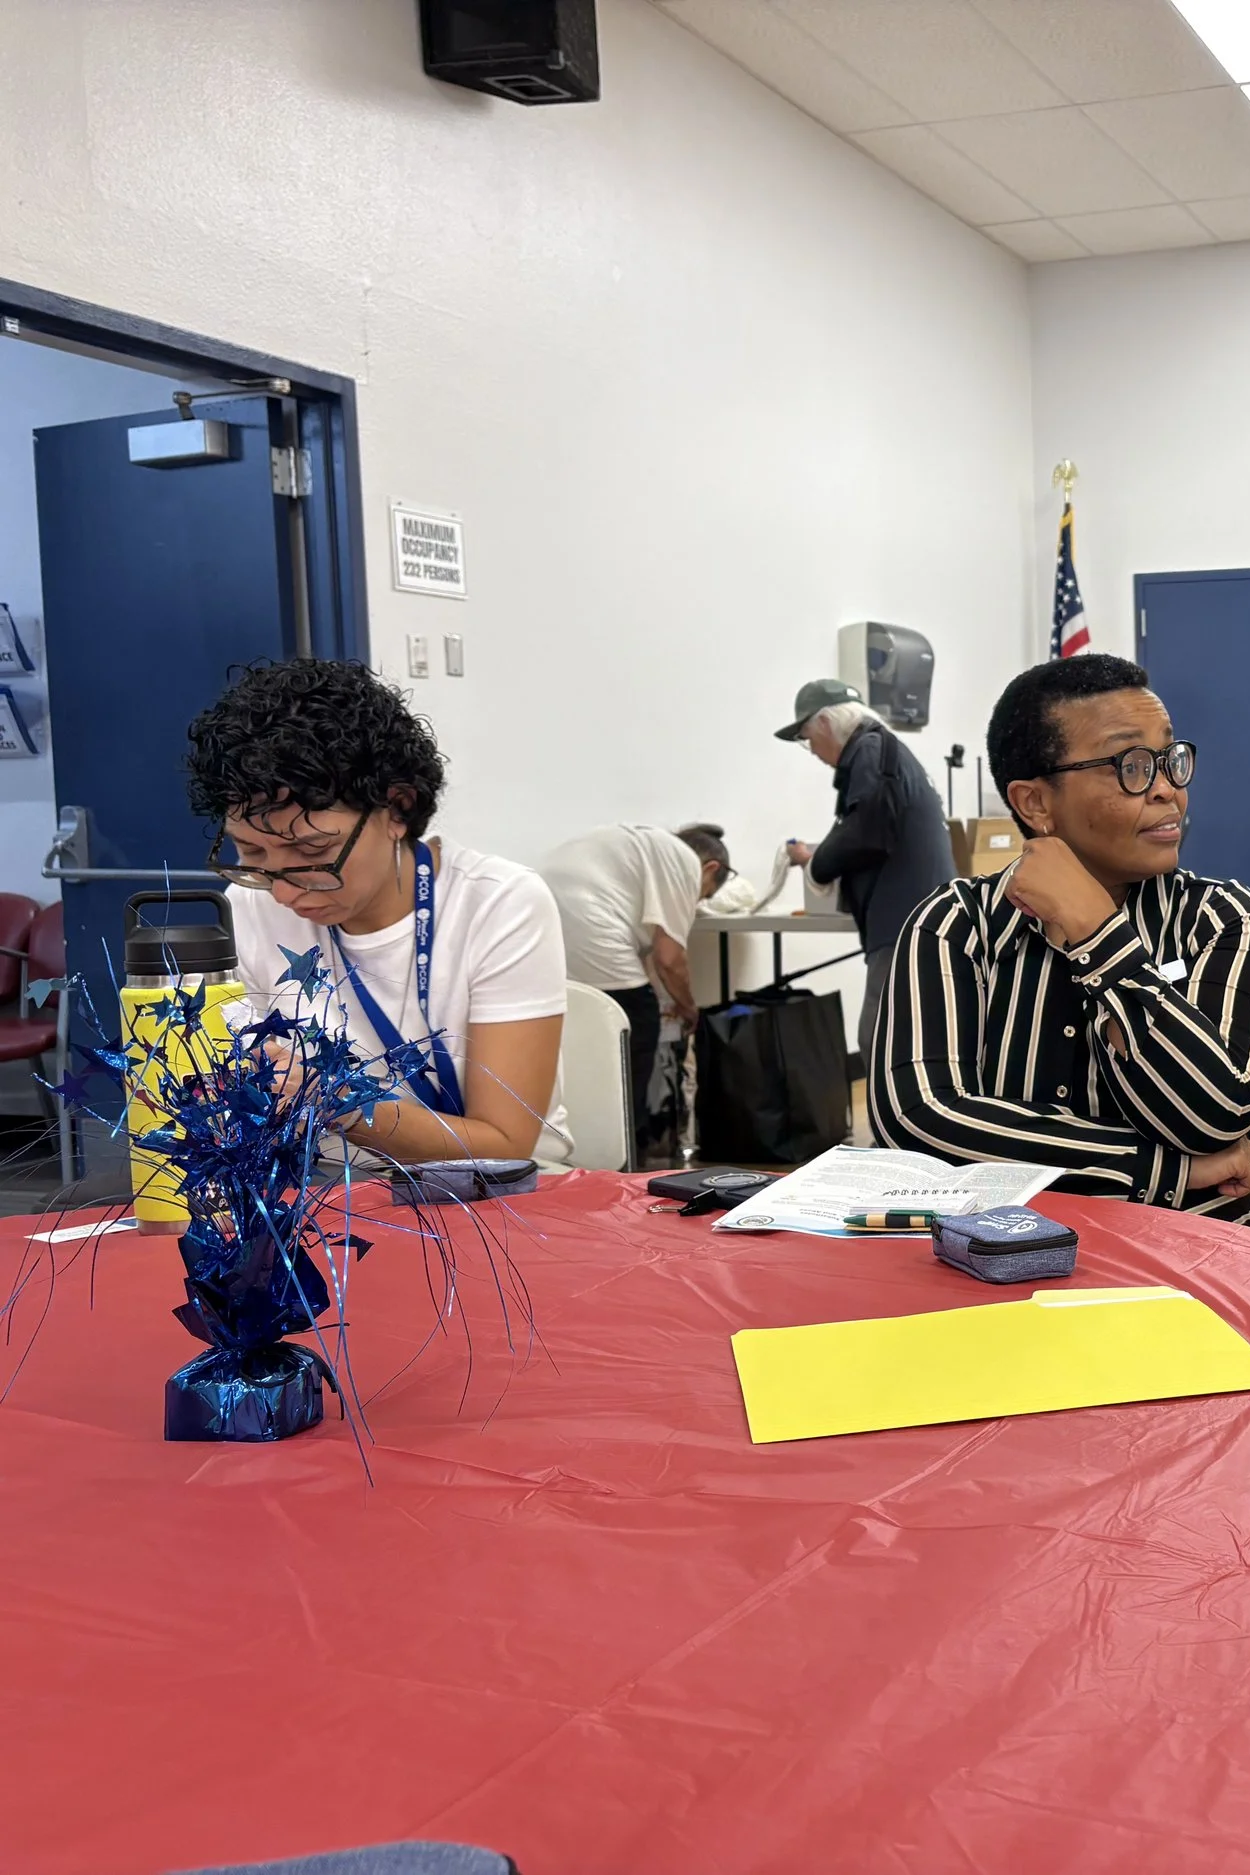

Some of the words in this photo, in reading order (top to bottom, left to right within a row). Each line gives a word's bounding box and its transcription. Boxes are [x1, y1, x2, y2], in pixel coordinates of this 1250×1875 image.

[403, 518, 455, 543] MAXIMUM
[402, 537, 458, 564] OCCUPANCY
[423, 564, 460, 584] PERSONS
[418, 875, 430, 902] PCOA
